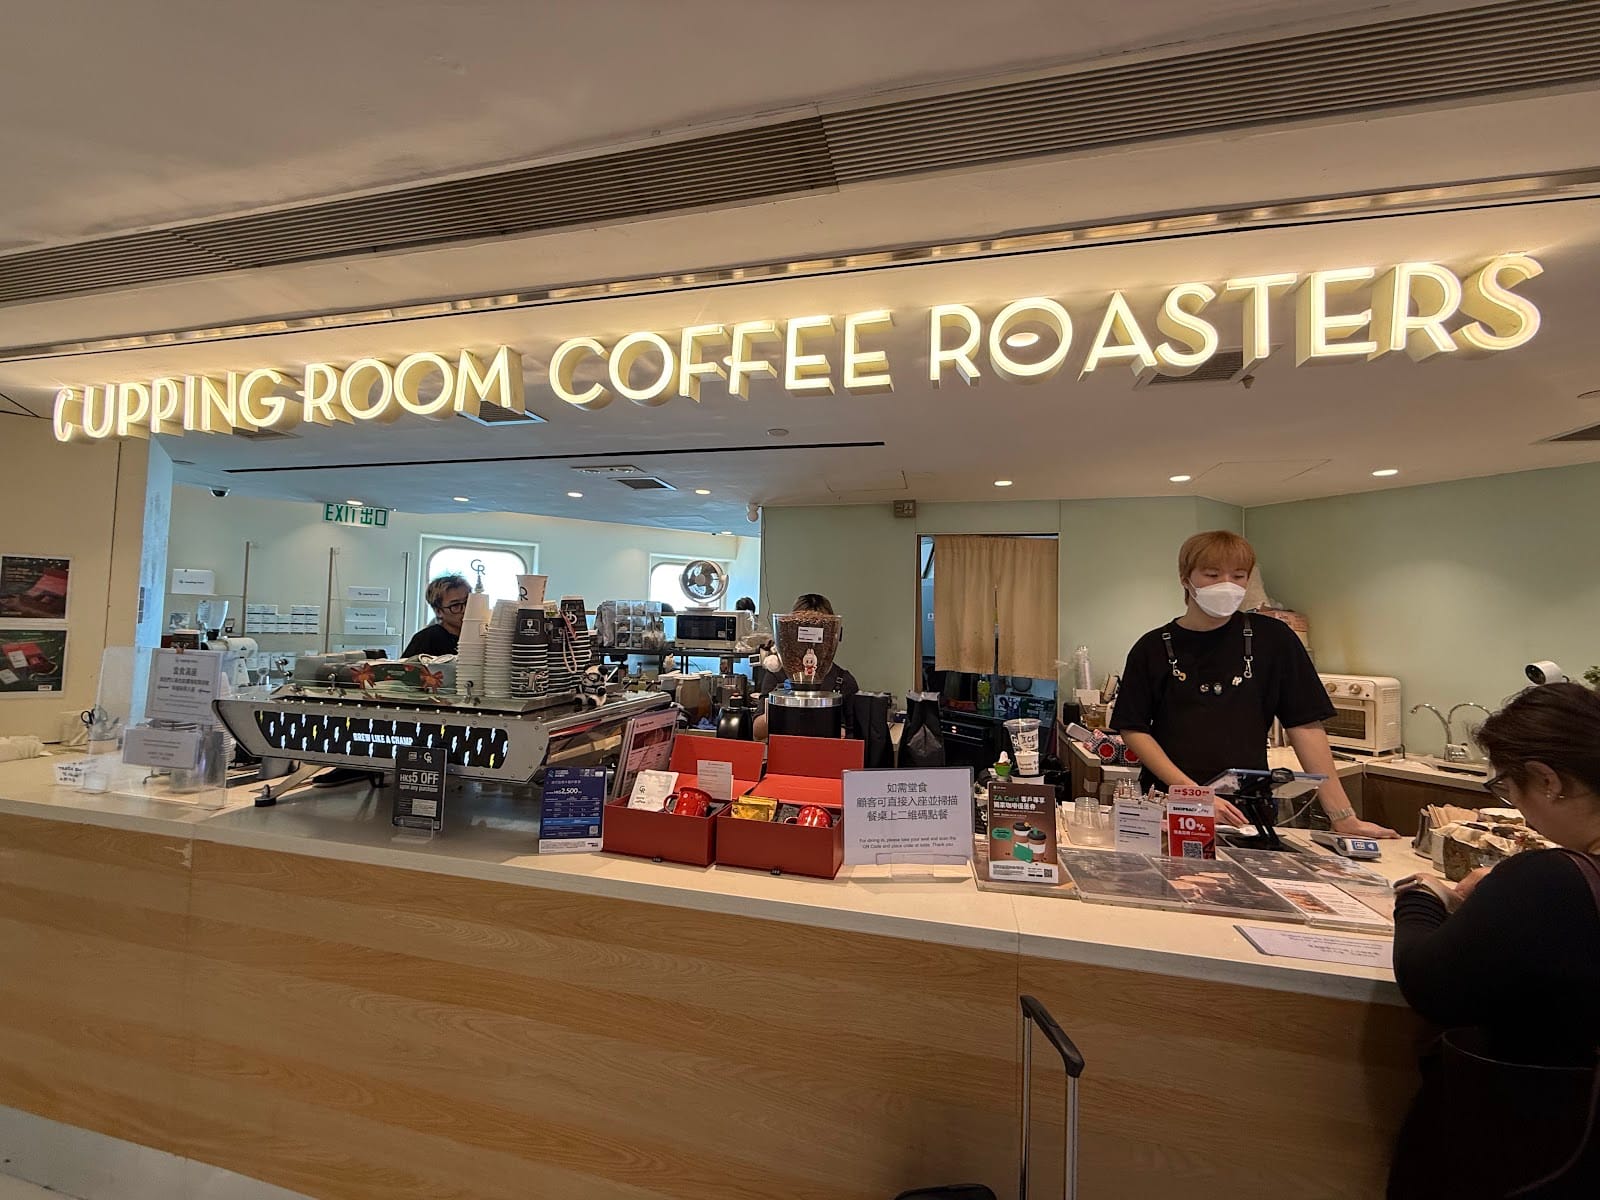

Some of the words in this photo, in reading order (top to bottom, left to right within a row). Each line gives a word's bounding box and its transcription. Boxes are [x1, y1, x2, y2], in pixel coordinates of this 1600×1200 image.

[53, 368, 288, 443] CUPPING
[303, 345, 518, 423] ROOM
[548, 310, 893, 408] COFFEE
[929, 251, 1545, 383] ROASTERS
[325, 503, 356, 523] EXIT
[360, 507, 387, 526] 出口
[352, 732, 371, 743] BREW
[371, 734, 386, 744] LIKE
[386, 735, 391, 744] A
[391, 736, 414, 746] CHAMP
[420, 773, 440, 785] OFF
[887, 782, 928, 793] 如需堂食
[1182, 789, 1202, 797] $30
[1178, 817, 1206, 831] 10%
